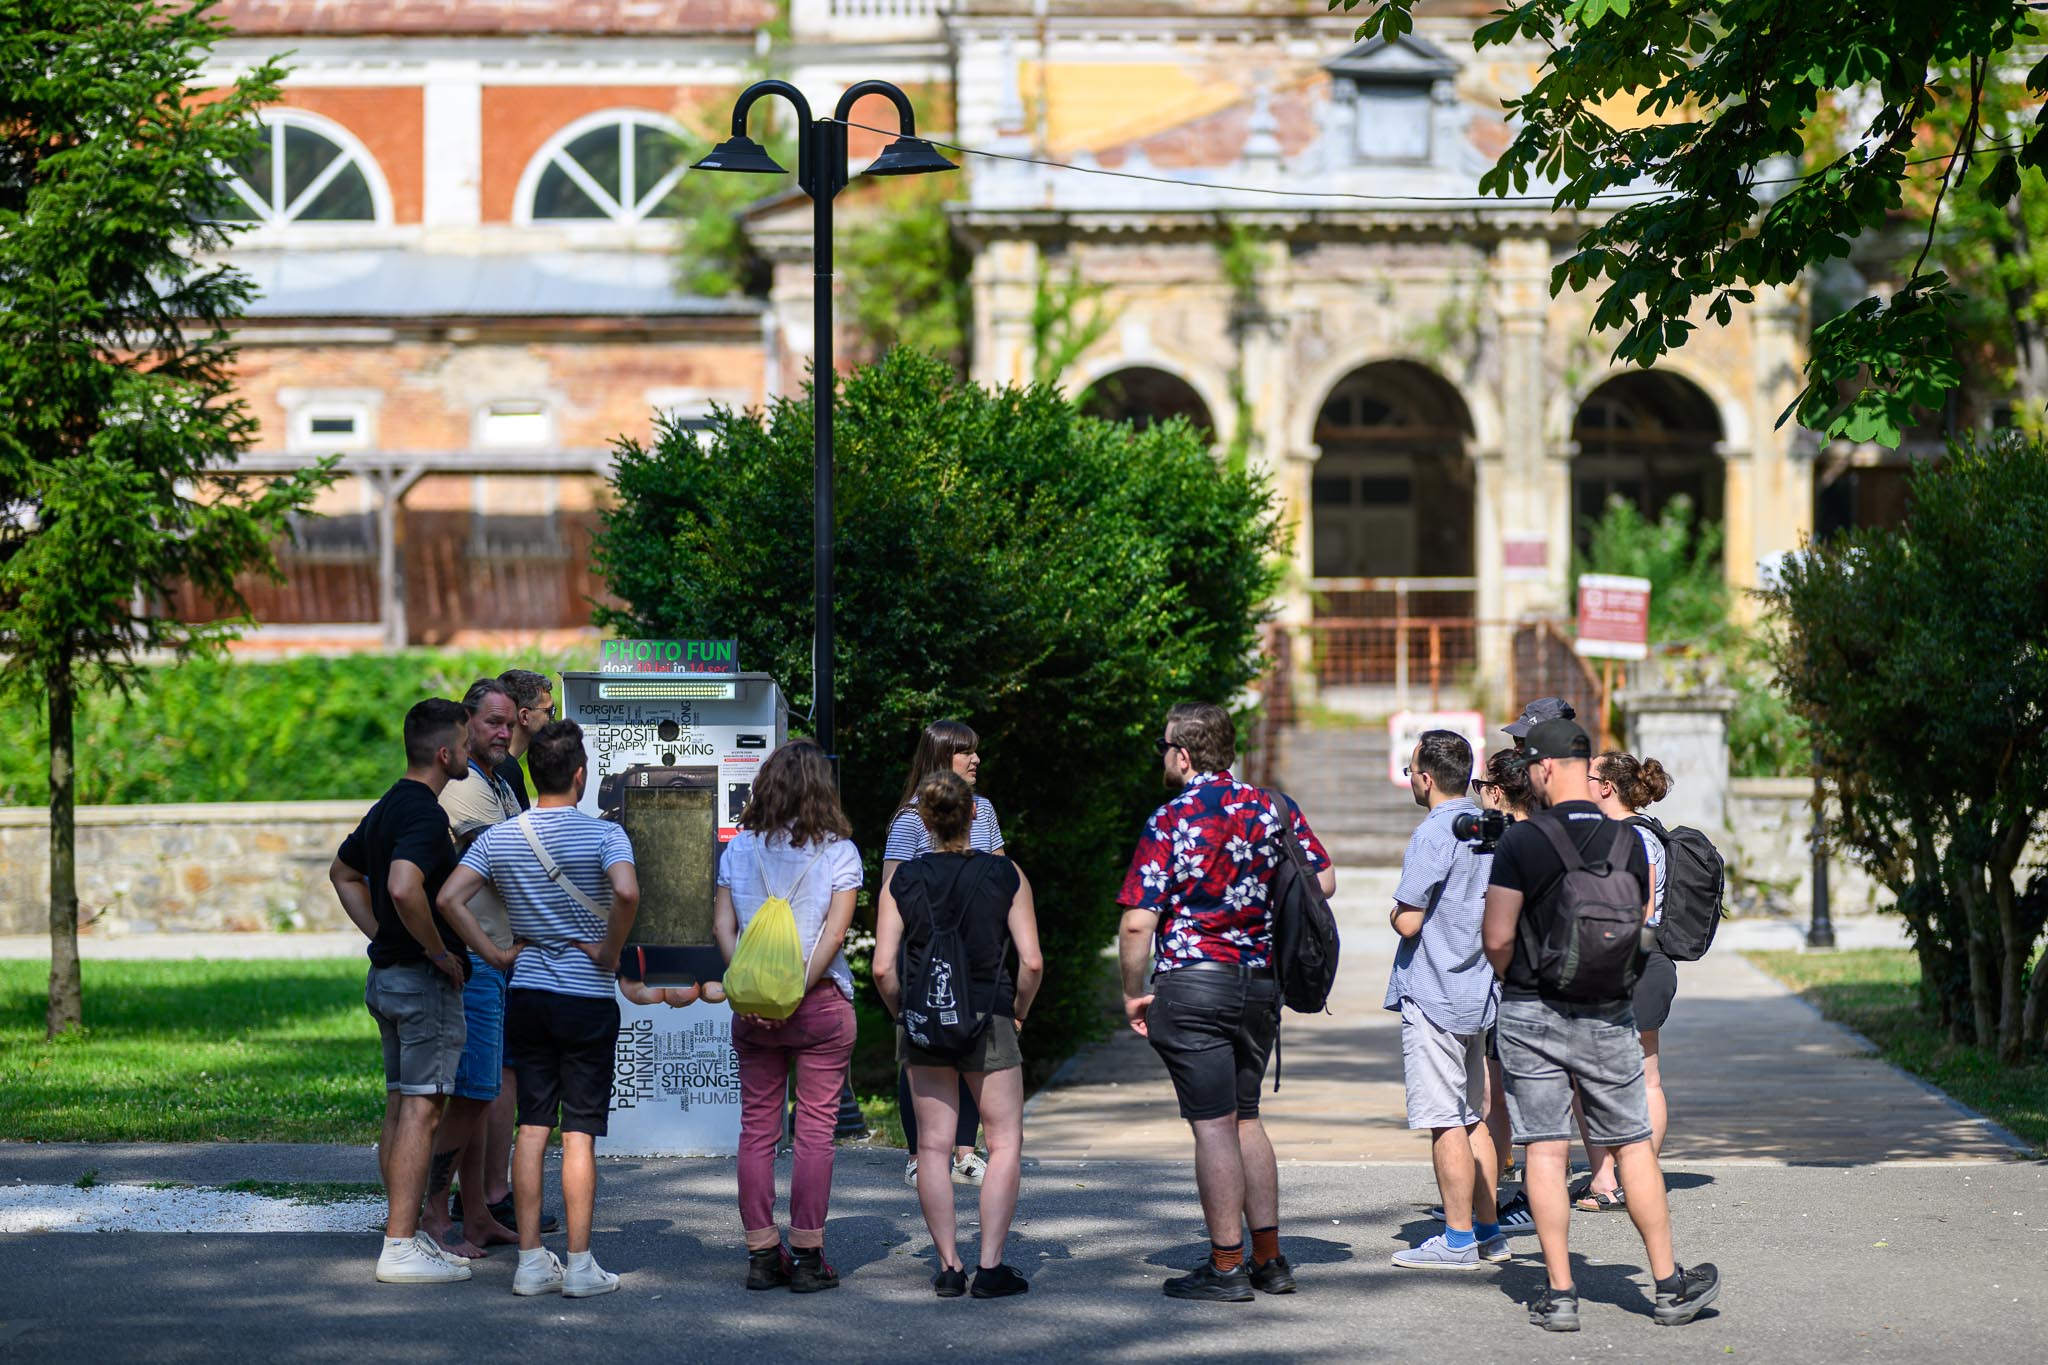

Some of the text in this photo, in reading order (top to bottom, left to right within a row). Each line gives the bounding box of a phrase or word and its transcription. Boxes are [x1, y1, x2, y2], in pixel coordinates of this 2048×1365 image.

[604, 642, 731, 661] PHOTO FUN
[602, 661, 633, 672] doar
[637, 662, 652, 672] 10
[655, 662, 670, 672] lei
[690, 662, 705, 672] 14
[580, 704, 624, 715] FORGIVE
[681, 701, 691, 743] STRONG
[598, 714, 611, 776] PEACEFUL
[610, 741, 646, 751] HAPPY
[653, 744, 714, 755] THINKING
[617, 1022, 636, 1109] PEACEFUL
[635, 1019, 653, 1102] THINKING
[653, 1063, 722, 1075] FORGIVE
[661, 1075, 729, 1088] STRONG
